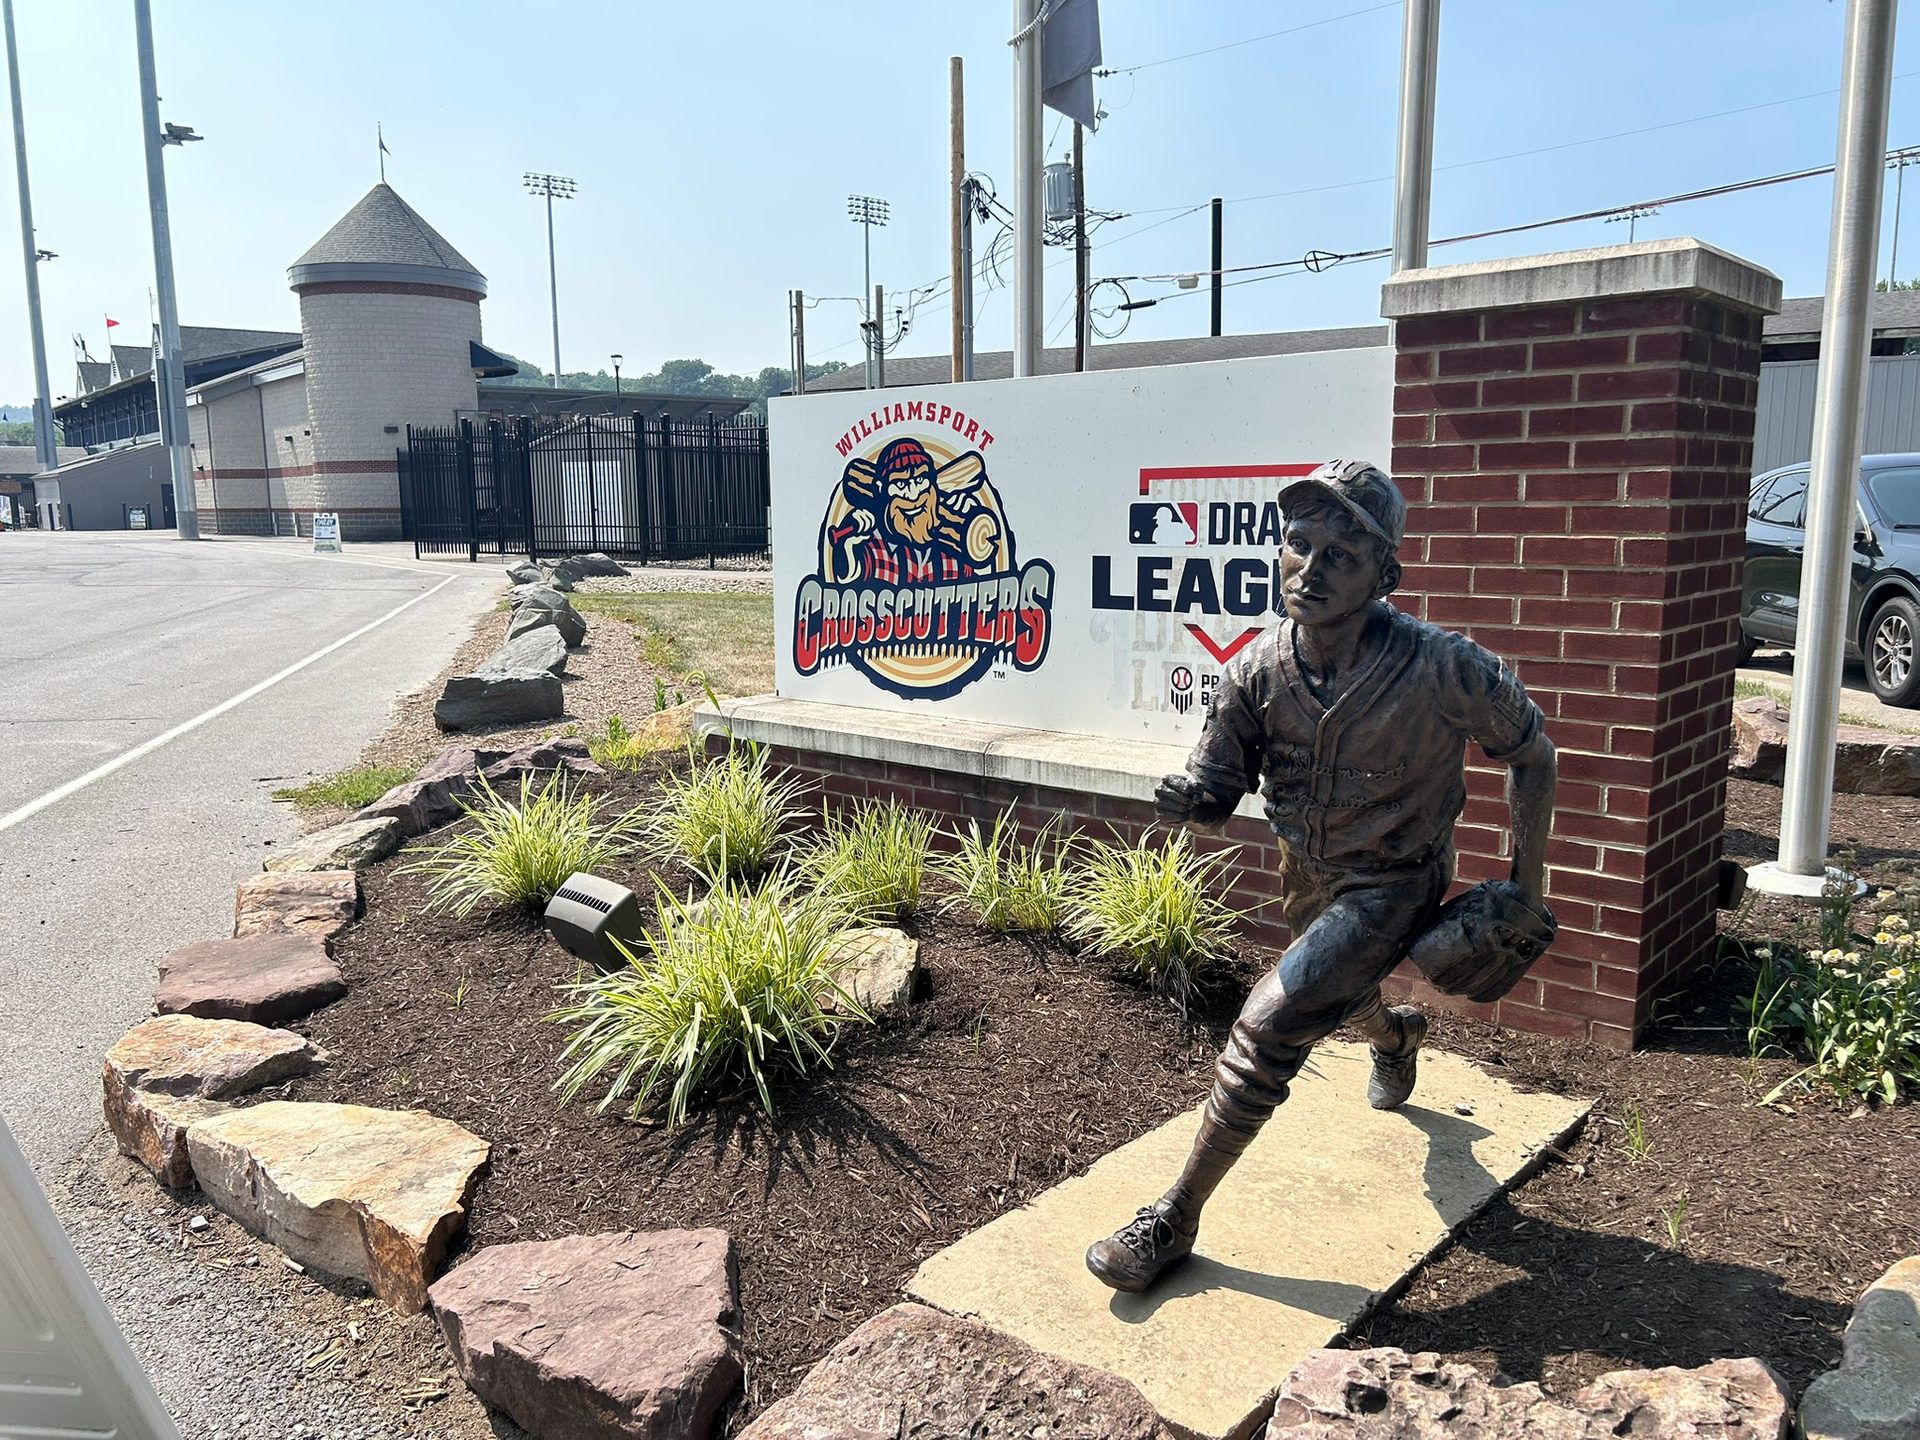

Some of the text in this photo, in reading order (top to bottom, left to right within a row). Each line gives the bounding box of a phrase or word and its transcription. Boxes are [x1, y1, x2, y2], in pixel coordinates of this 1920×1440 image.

[835, 401, 995, 458] WILLIAMSPORT
[1208, 502, 1282, 545] DRA
[1092, 555, 1289, 618] LEAG
[796, 565, 1050, 670] CROSSCUTTERS
[993, 670, 1006, 679] TM
